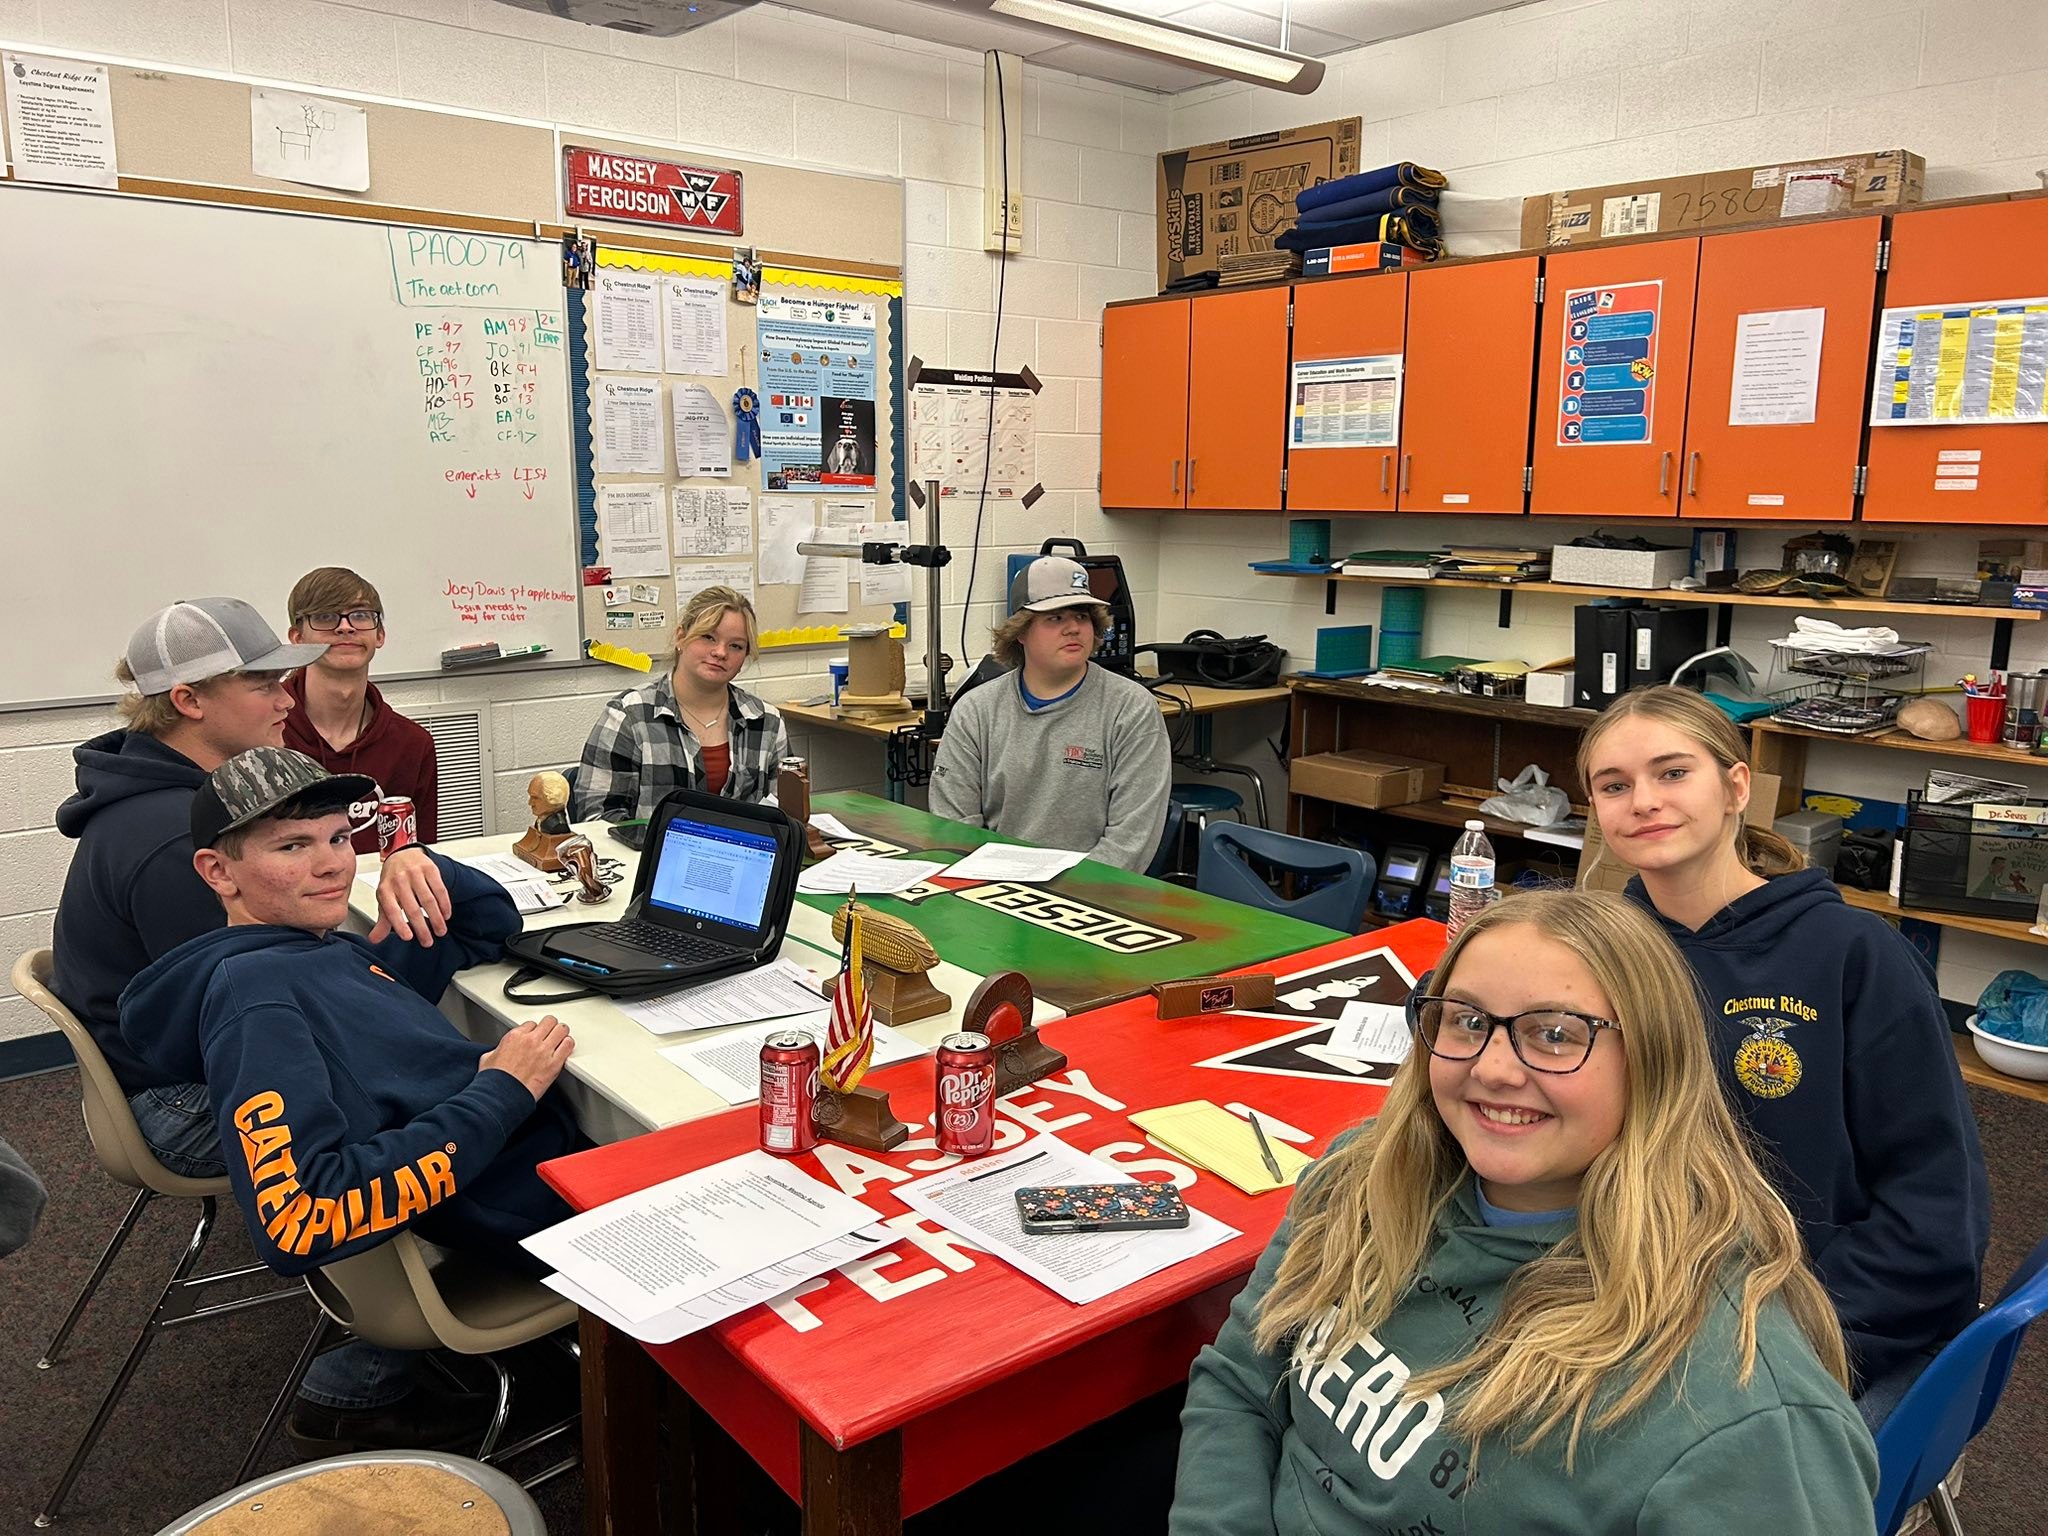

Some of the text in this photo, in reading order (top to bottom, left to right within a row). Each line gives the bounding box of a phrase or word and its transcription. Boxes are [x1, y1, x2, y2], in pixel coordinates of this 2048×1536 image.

[31, 69, 61, 79] Chestnut
[63, 72, 82, 81] Ridge
[588, 155, 657, 185] MASSEY
[577, 184, 670, 215] FERGUSON
[1672, 182, 1768, 226] 7580
[1167, 188, 1185, 263] ArtSkills
[1188, 200, 1196, 251] TRIFOLD
[614, 280, 636, 288] Chestnut
[780, 296, 806, 306] Become
[812, 300, 835, 311] Hunger
[836, 303, 859, 312] Fighter!
[415, 322, 433, 339] PE
[484, 318, 508, 335] AM
[1574, 326, 1586, 337] P
[786, 336, 812, 344] Pennsylvania
[851, 341, 869, 349] Security?
[1567, 351, 1581, 361] R
[954, 374, 973, 383] Welding
[1631, 361, 1655, 380] WOW
[1571, 376, 1582, 388] I
[1565, 401, 1578, 412] D
[1566, 425, 1580, 437] E
[442, 579, 474, 600] Joey
[475, 581, 506, 596] Davis
[527, 589, 550, 602] apple
[482, 611, 496, 621] for
[2004, 810, 2028, 821] Seuss
[978, 884, 1172, 950] DIESEL
[1723, 995, 1818, 1021] Chestnut Ridge
[1755, 1053, 1781, 1066] FFA
[959, 1071, 983, 1090] Dr
[1748, 1077, 1787, 1090] EDUCATION
[940, 1073, 993, 1107] Pepper
[952, 1113, 967, 1126] 23
[960, 1159, 1004, 1176] Addison
[1291, 1303, 1445, 1480] AERO
